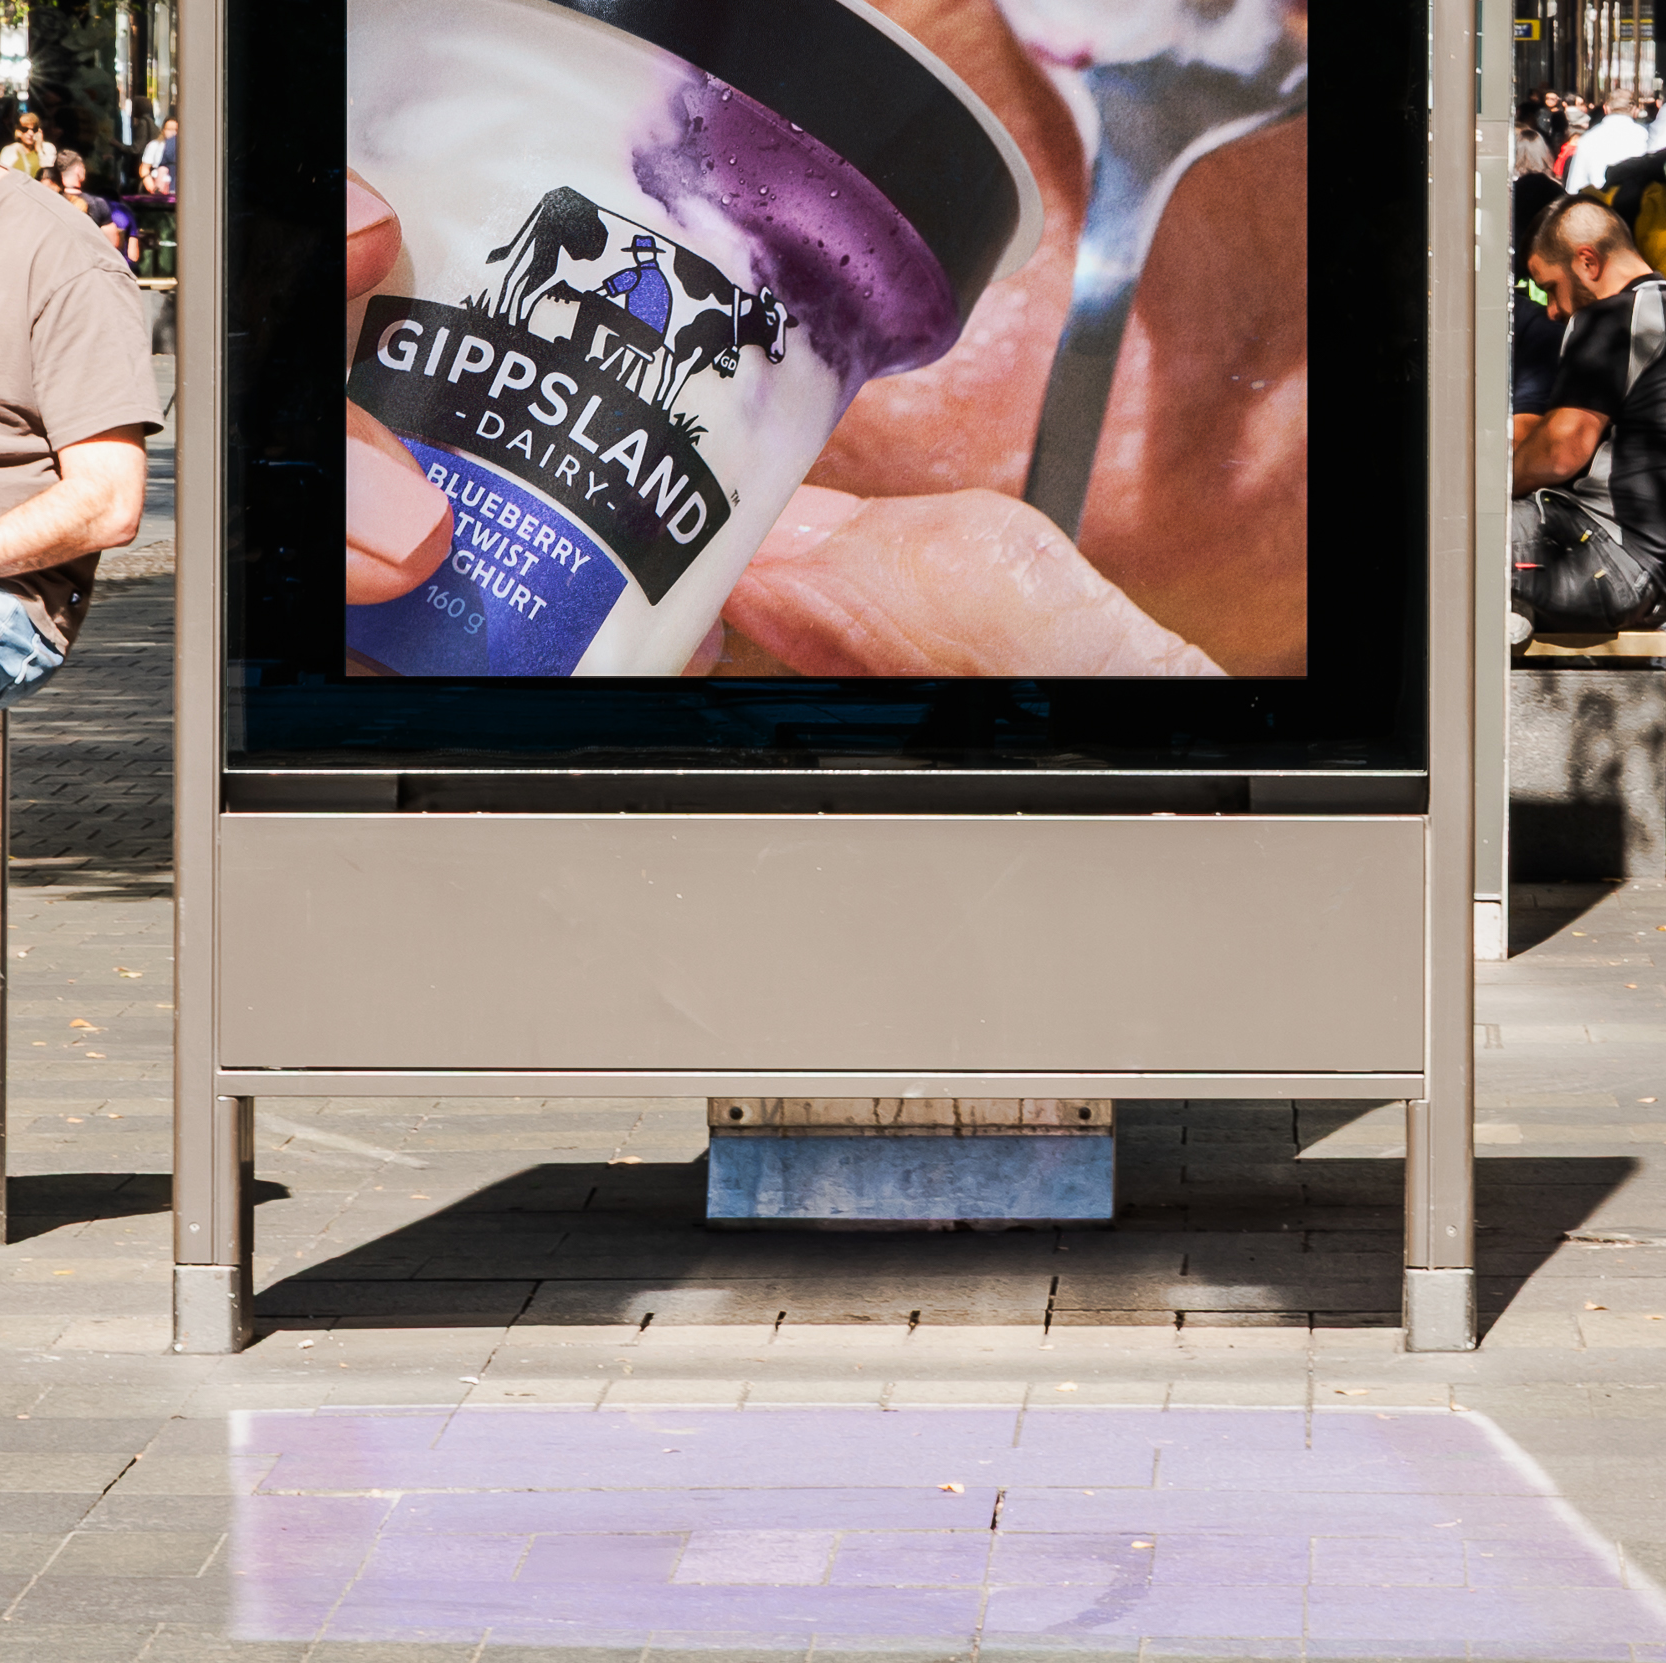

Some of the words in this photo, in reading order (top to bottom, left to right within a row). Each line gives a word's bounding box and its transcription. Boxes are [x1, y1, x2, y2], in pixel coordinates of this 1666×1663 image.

[720, 355, 737, 371] GD
[377, 319, 707, 544] GIPPSLAND
[426, 463, 591, 574] BLUEBERRY
[454, 511, 540, 576] TWIST
[426, 585, 466, 618] 160
[463, 613, 486, 635] g
[445, 544, 547, 621] GHURT
